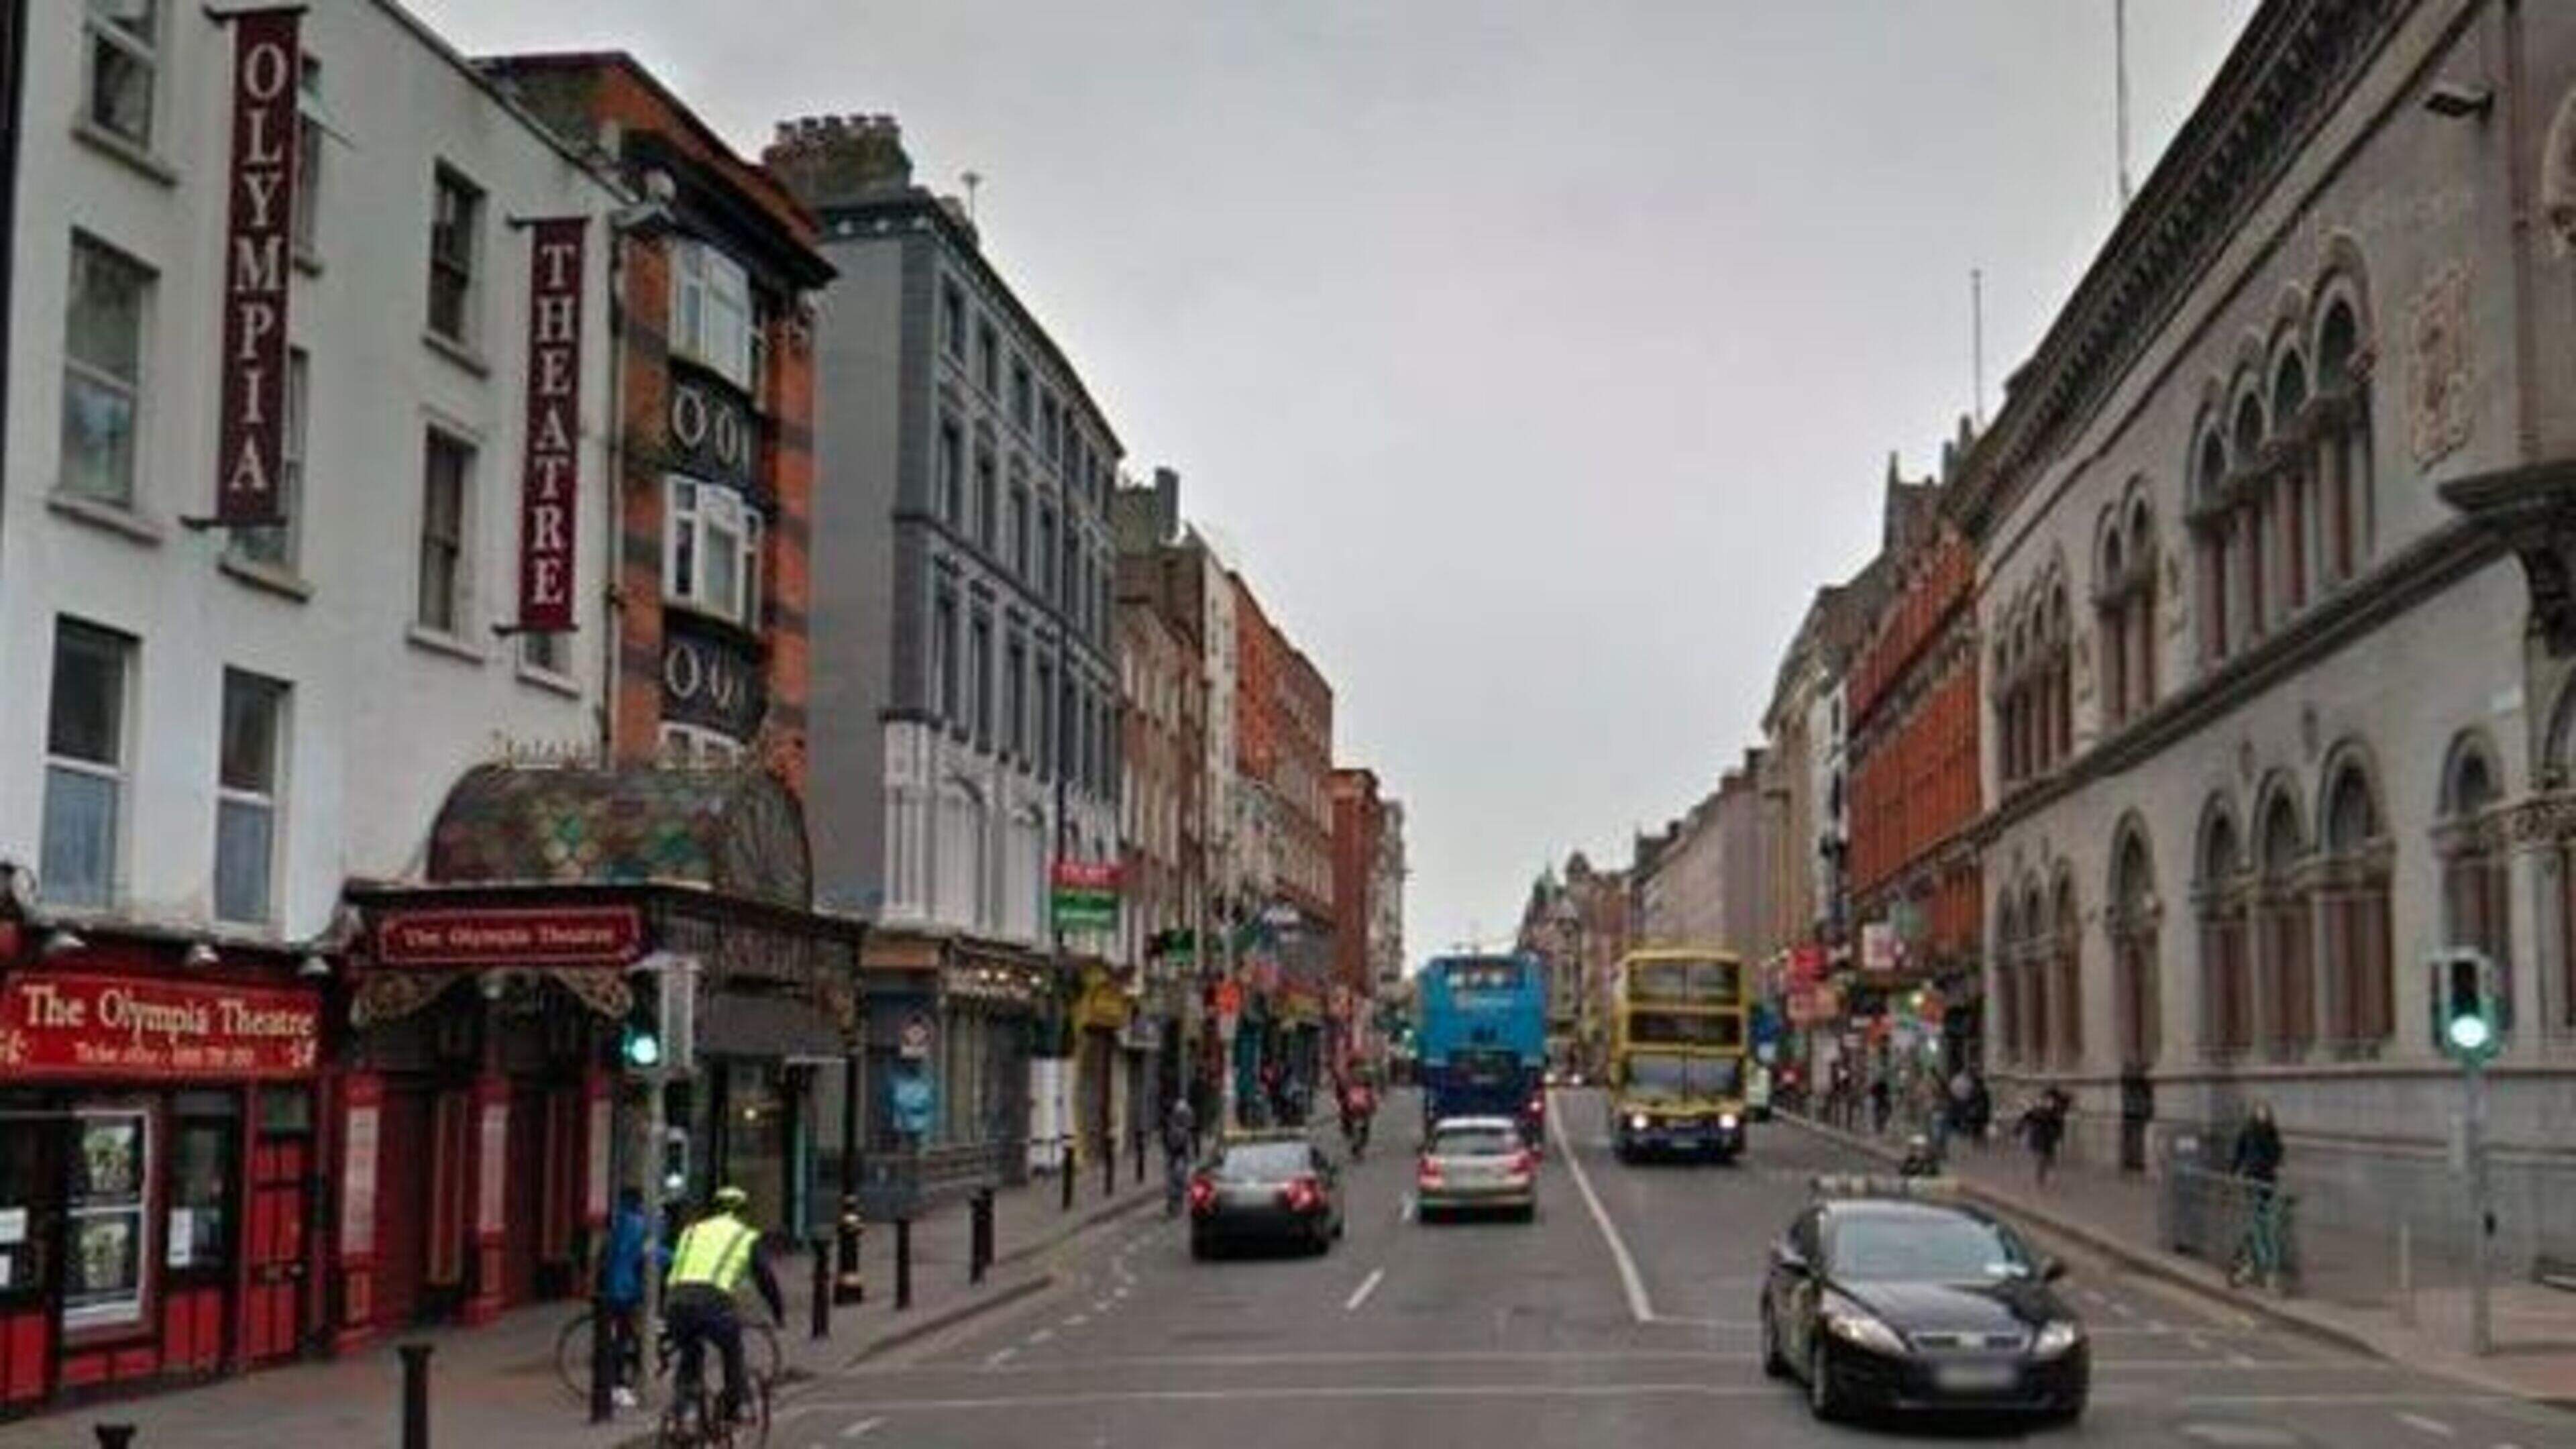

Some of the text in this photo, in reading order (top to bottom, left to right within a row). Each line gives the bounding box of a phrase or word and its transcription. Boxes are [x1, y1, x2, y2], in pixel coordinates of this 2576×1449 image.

[229, 42, 286, 492] OLYMPIA
[532, 243, 576, 606] THEATRE
[22, 984, 316, 1042] The Olympia Theatre
[402, 925, 615, 949] The Olympia Theatre
